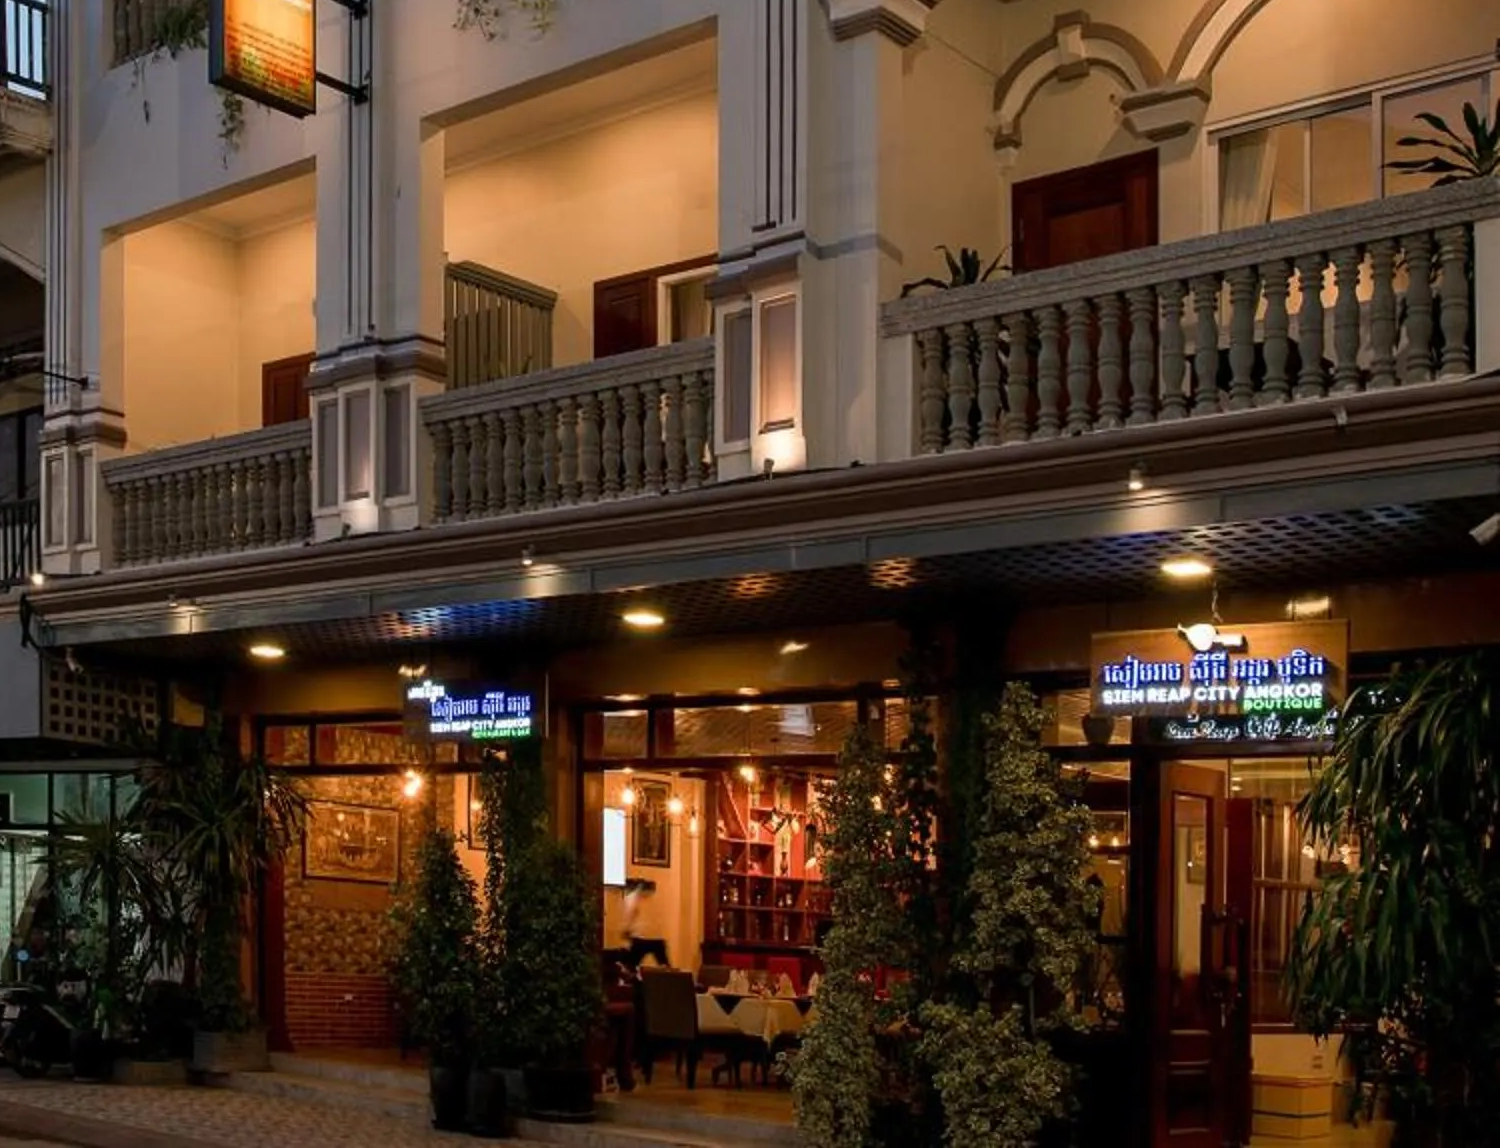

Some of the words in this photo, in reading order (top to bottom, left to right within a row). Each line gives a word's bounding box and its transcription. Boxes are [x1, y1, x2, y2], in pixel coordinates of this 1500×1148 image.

[1102, 688, 1146, 705] SIEM
[1147, 685, 1191, 703] REAP
[1193, 684, 1240, 701] CITY
[1242, 681, 1323, 700] ANGKOR
[1242, 697, 1323, 712] BOUTIQUE
[471, 718, 496, 731] CITY
